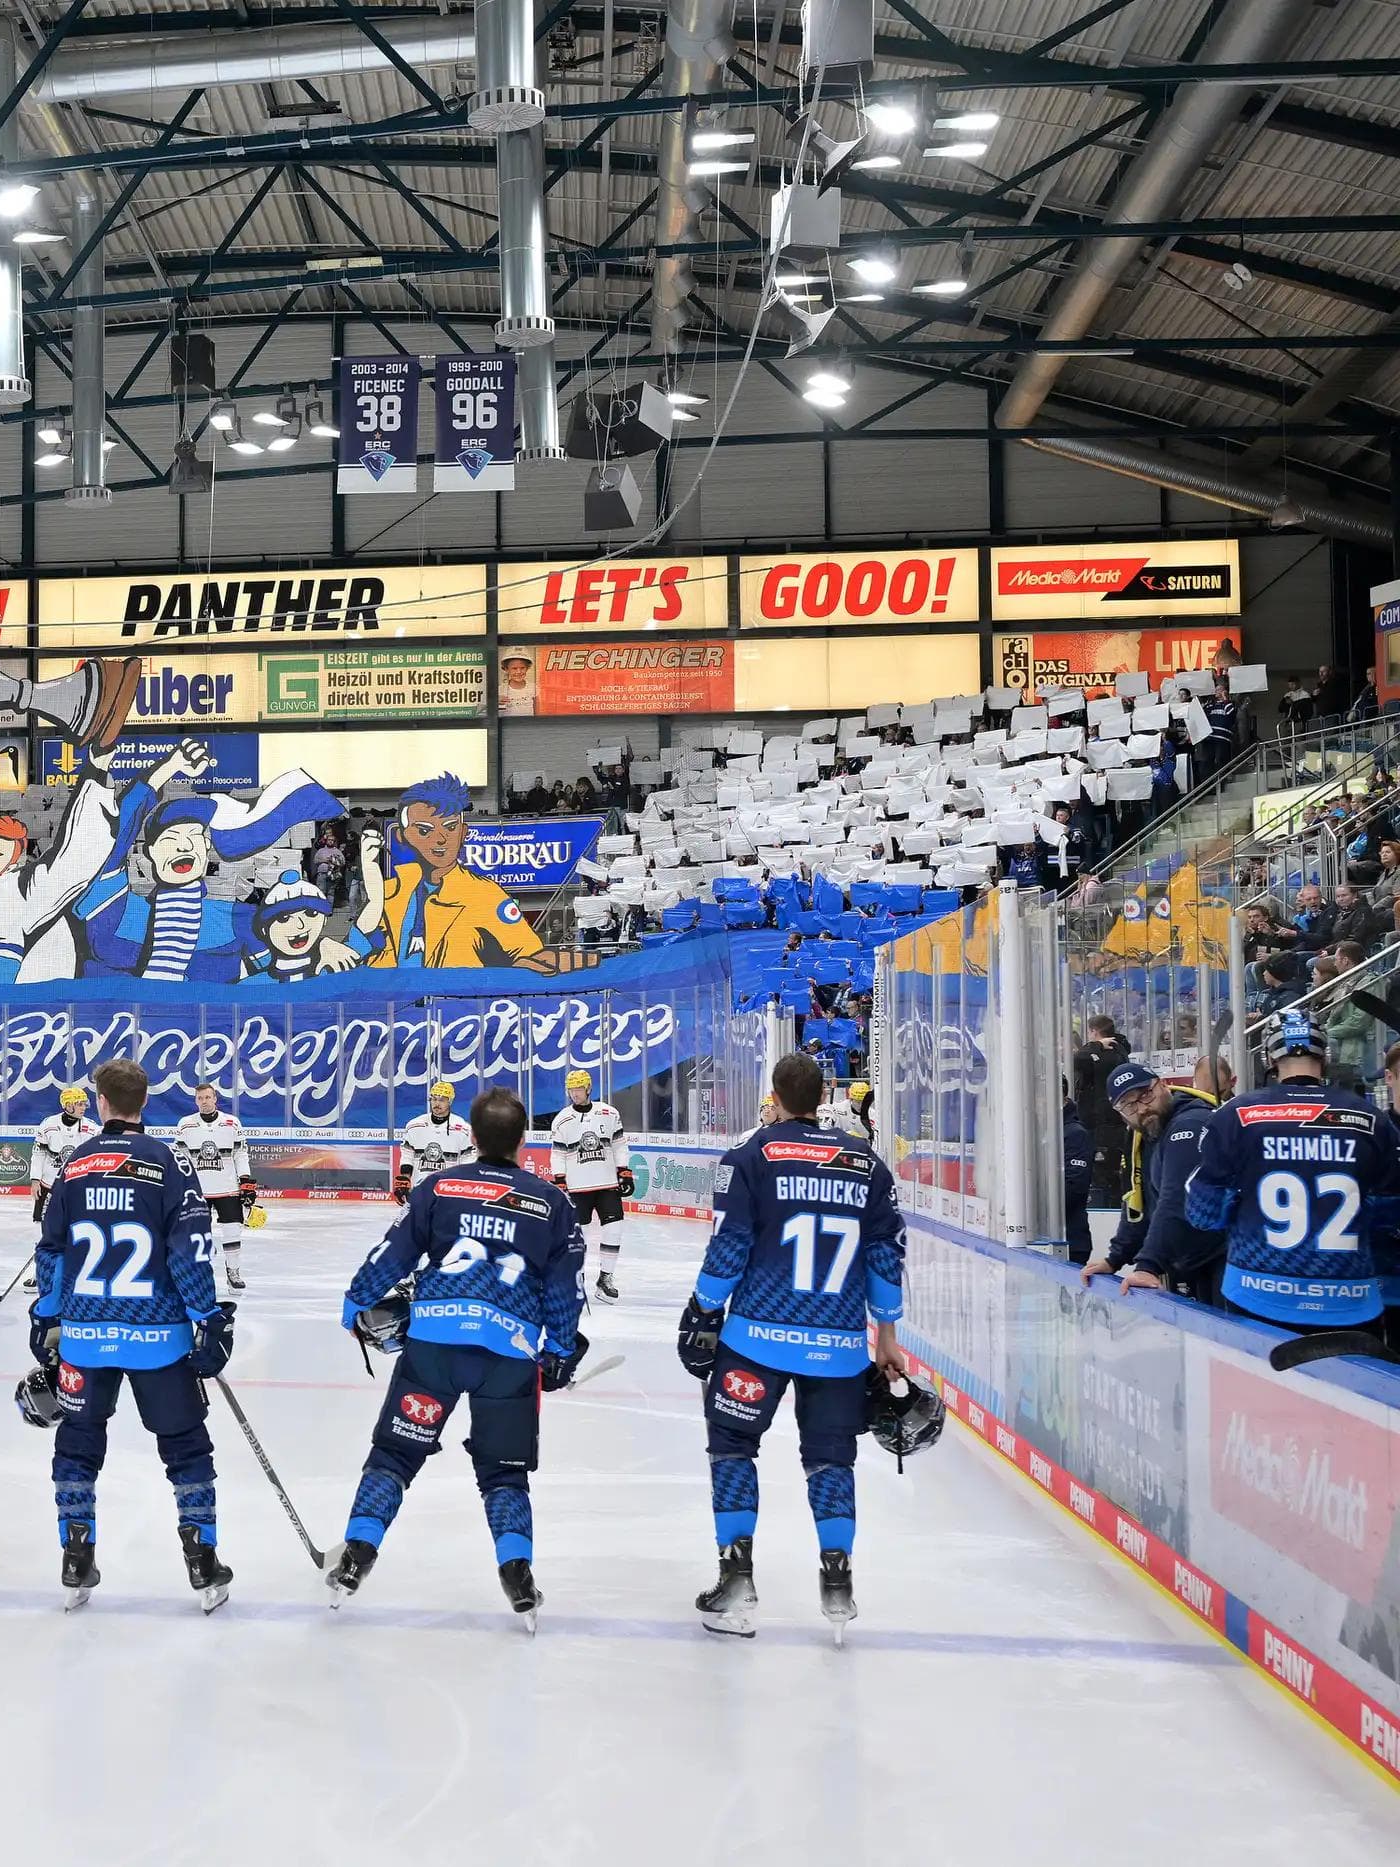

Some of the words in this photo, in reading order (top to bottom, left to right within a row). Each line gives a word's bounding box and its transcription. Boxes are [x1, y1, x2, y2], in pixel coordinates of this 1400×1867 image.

[354, 379, 405, 394] FICENEC
[446, 377, 504, 391] GOODALL
[356, 394, 402, 432] 38
[452, 392, 498, 430] 96
[364, 440, 391, 449] ERC
[759, 557, 957, 620] GOOO!
[1167, 574, 1222, 591] SATURN
[120, 577, 386, 637] PANTHER
[540, 565, 690, 625] LET'S
[327, 652, 369, 665] EISZEIT
[371, 653, 391, 666] gibt
[392, 654, 404, 664] es
[406, 654, 423, 663] nur
[425, 652, 434, 662] in
[436, 652, 453, 662] der
[454, 651, 484, 662] Arena
[545, 646, 725, 671] HECHINGER
[1034, 661, 1069, 673] DAS
[1154, 639, 1218, 673] LIVE
[327, 670, 372, 688] Heizöl
[377, 670, 403, 687] und
[407, 669, 484, 685] Kraftstoffe
[1034, 672, 1116, 687] ORIGINAL
[269, 700, 317, 712] GUNVOR
[327, 690, 370, 706] direkt
[375, 692, 406, 705] vom
[411, 688, 484, 705] Hersteller
[212, 776, 253, 785] Resources
[250, 1145, 269, 1153] PUCK
[1263, 1134, 1357, 1163] SCHMÖLZ
[85, 1187, 135, 1212] BODIE
[775, 1175, 869, 1209] GIRDUCKIS
[1258, 1171, 1363, 1252] 92
[459, 1213, 517, 1243] SHEEN
[70, 1220, 154, 1298] 22
[781, 1212, 862, 1295] 17
[1240, 1275, 1370, 1298] INGOLSTADT
[748, 1325, 864, 1349] INGOLSTADT
